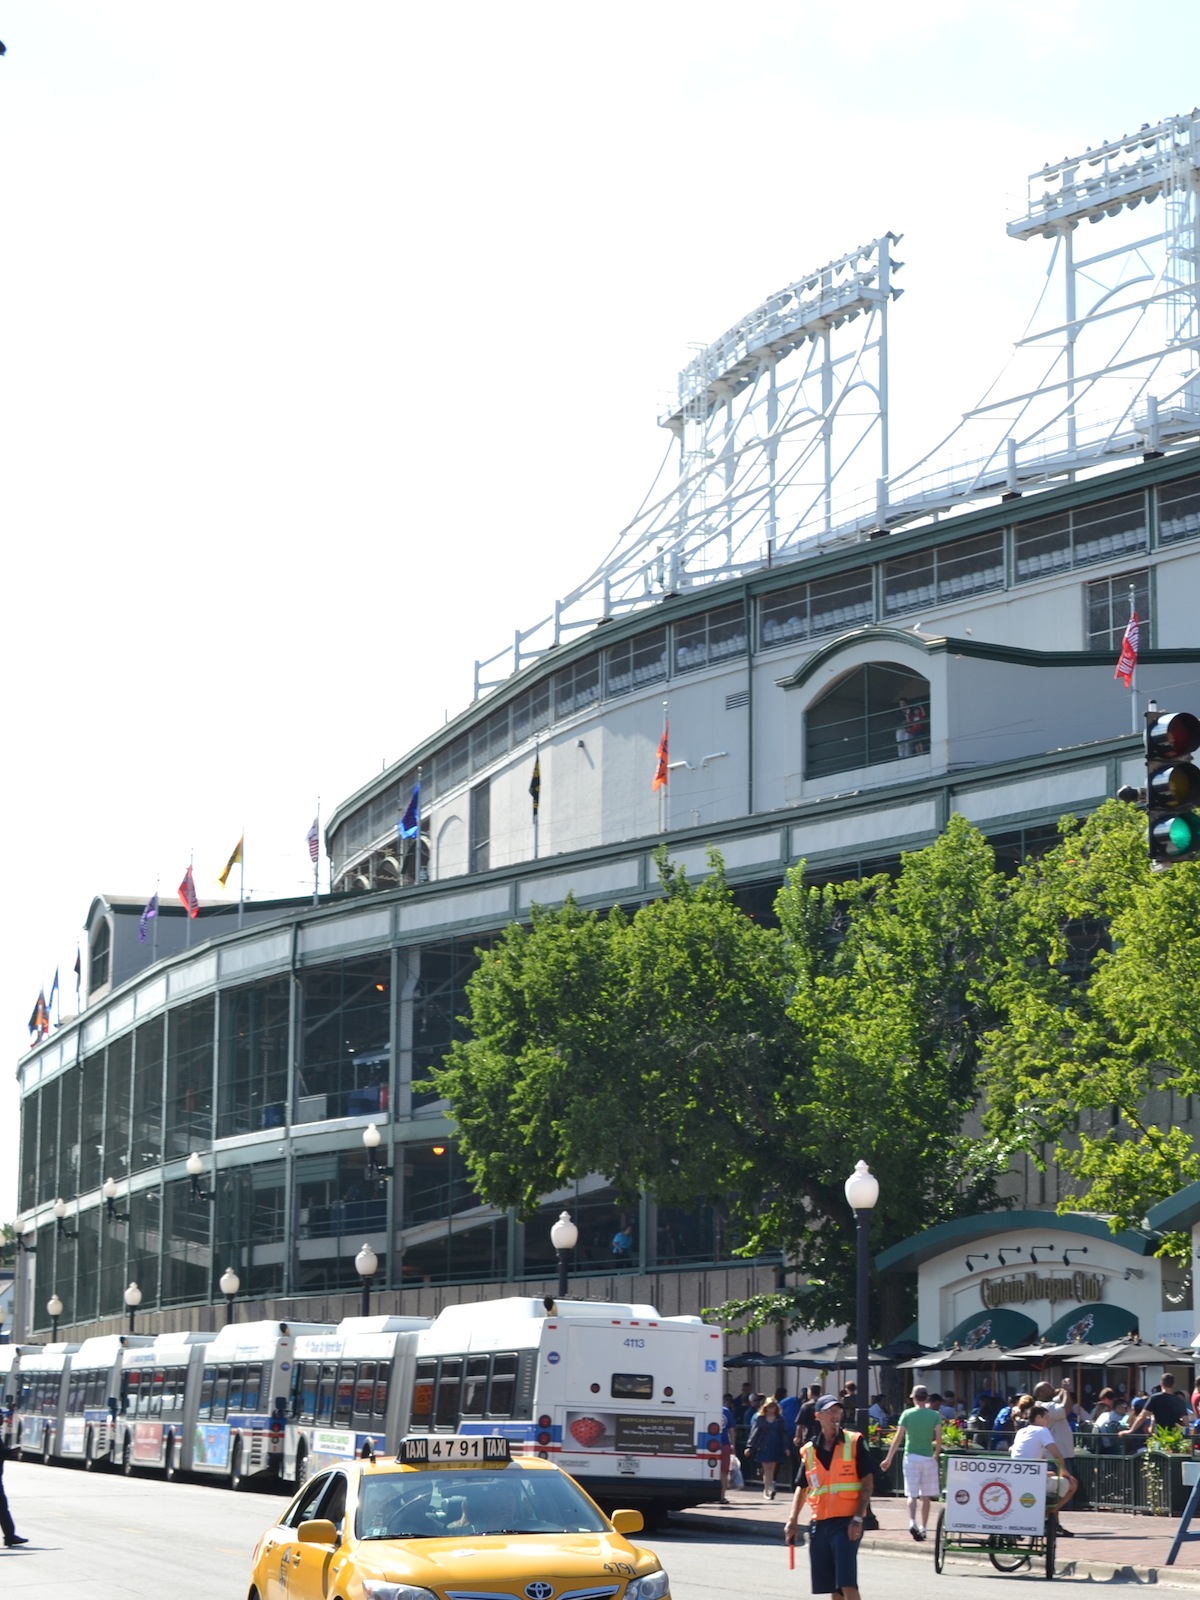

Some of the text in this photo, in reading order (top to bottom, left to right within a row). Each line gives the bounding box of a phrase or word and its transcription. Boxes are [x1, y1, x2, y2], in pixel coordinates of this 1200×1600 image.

[980, 1270, 1101, 1309] Captain Morgan Club
[623, 1338, 645, 1349] 4113
[405, 1439, 507, 1458] TAXI 4791 TAXI
[954, 1461, 1041, 1475] 1.800.977.9751
[603, 1562, 637, 1576] 4791
